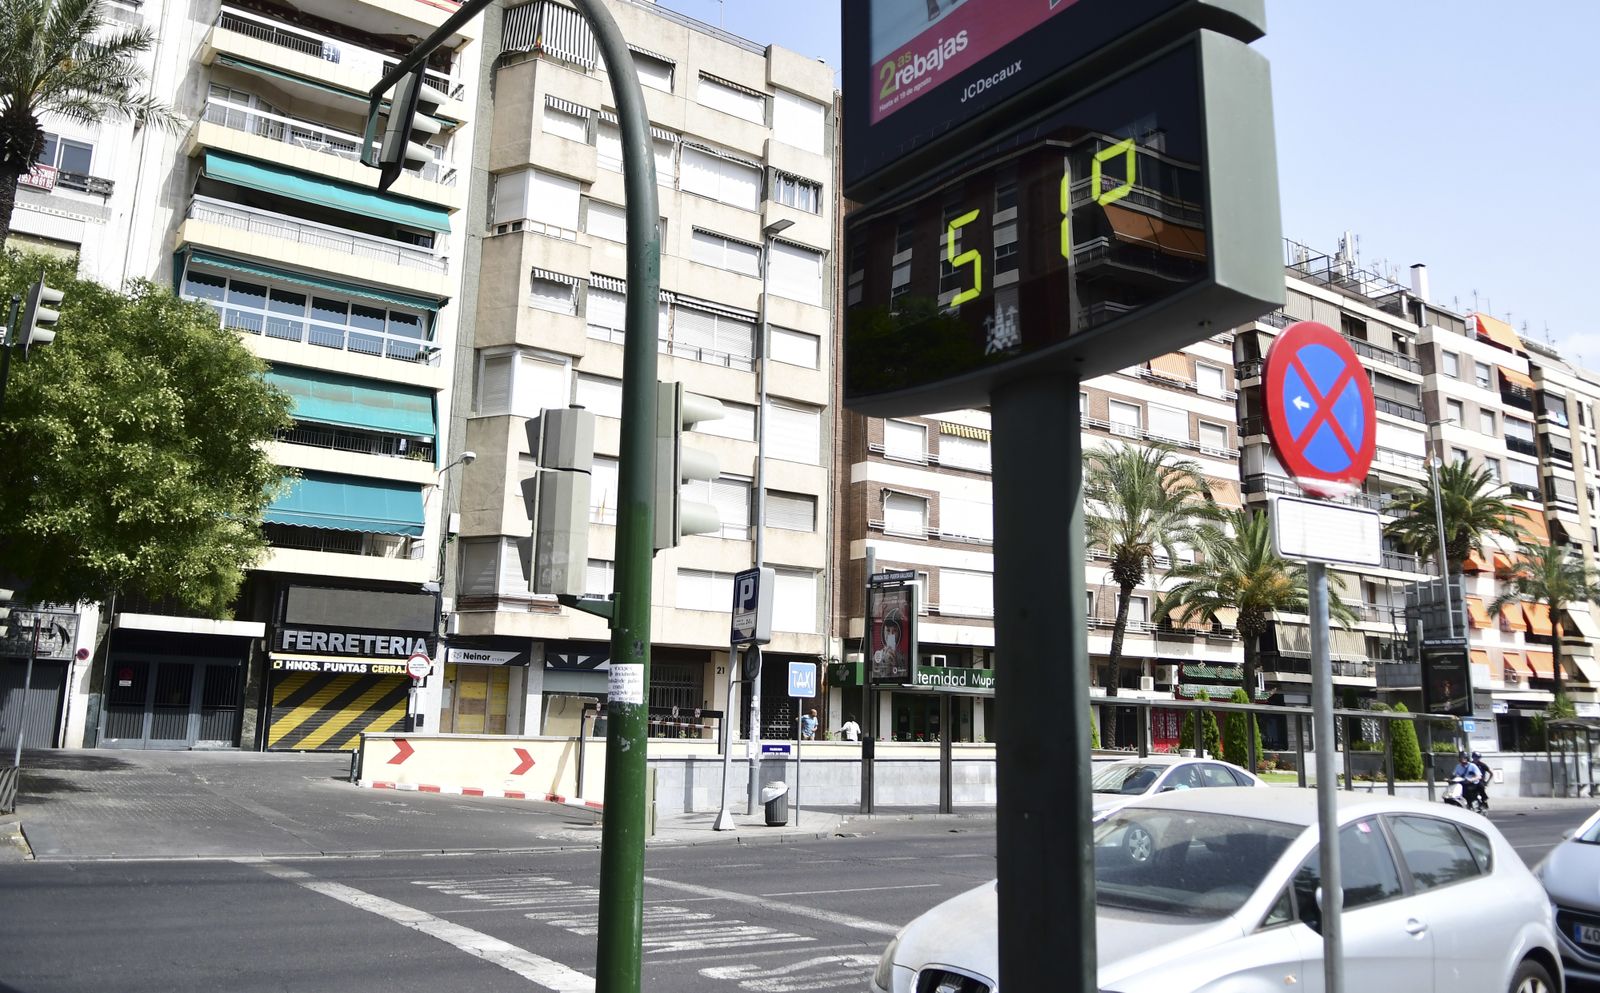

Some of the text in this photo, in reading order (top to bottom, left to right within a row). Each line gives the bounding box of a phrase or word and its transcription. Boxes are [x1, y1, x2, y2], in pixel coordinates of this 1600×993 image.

[895, 30, 968, 90] rebajas
[961, 60, 1022, 103] JCDecaux
[739, 578, 754, 614] P
[282, 630, 428, 655] FERRETERIA
[463, 652, 491, 661] Neinor
[285, 660, 321, 672] HNOS.
[323, 662, 367, 673] PUNTAS
[716, 666, 725, 675] 21
[792, 670, 814, 689] TAXI
[918, 669, 966, 686] ternidad
